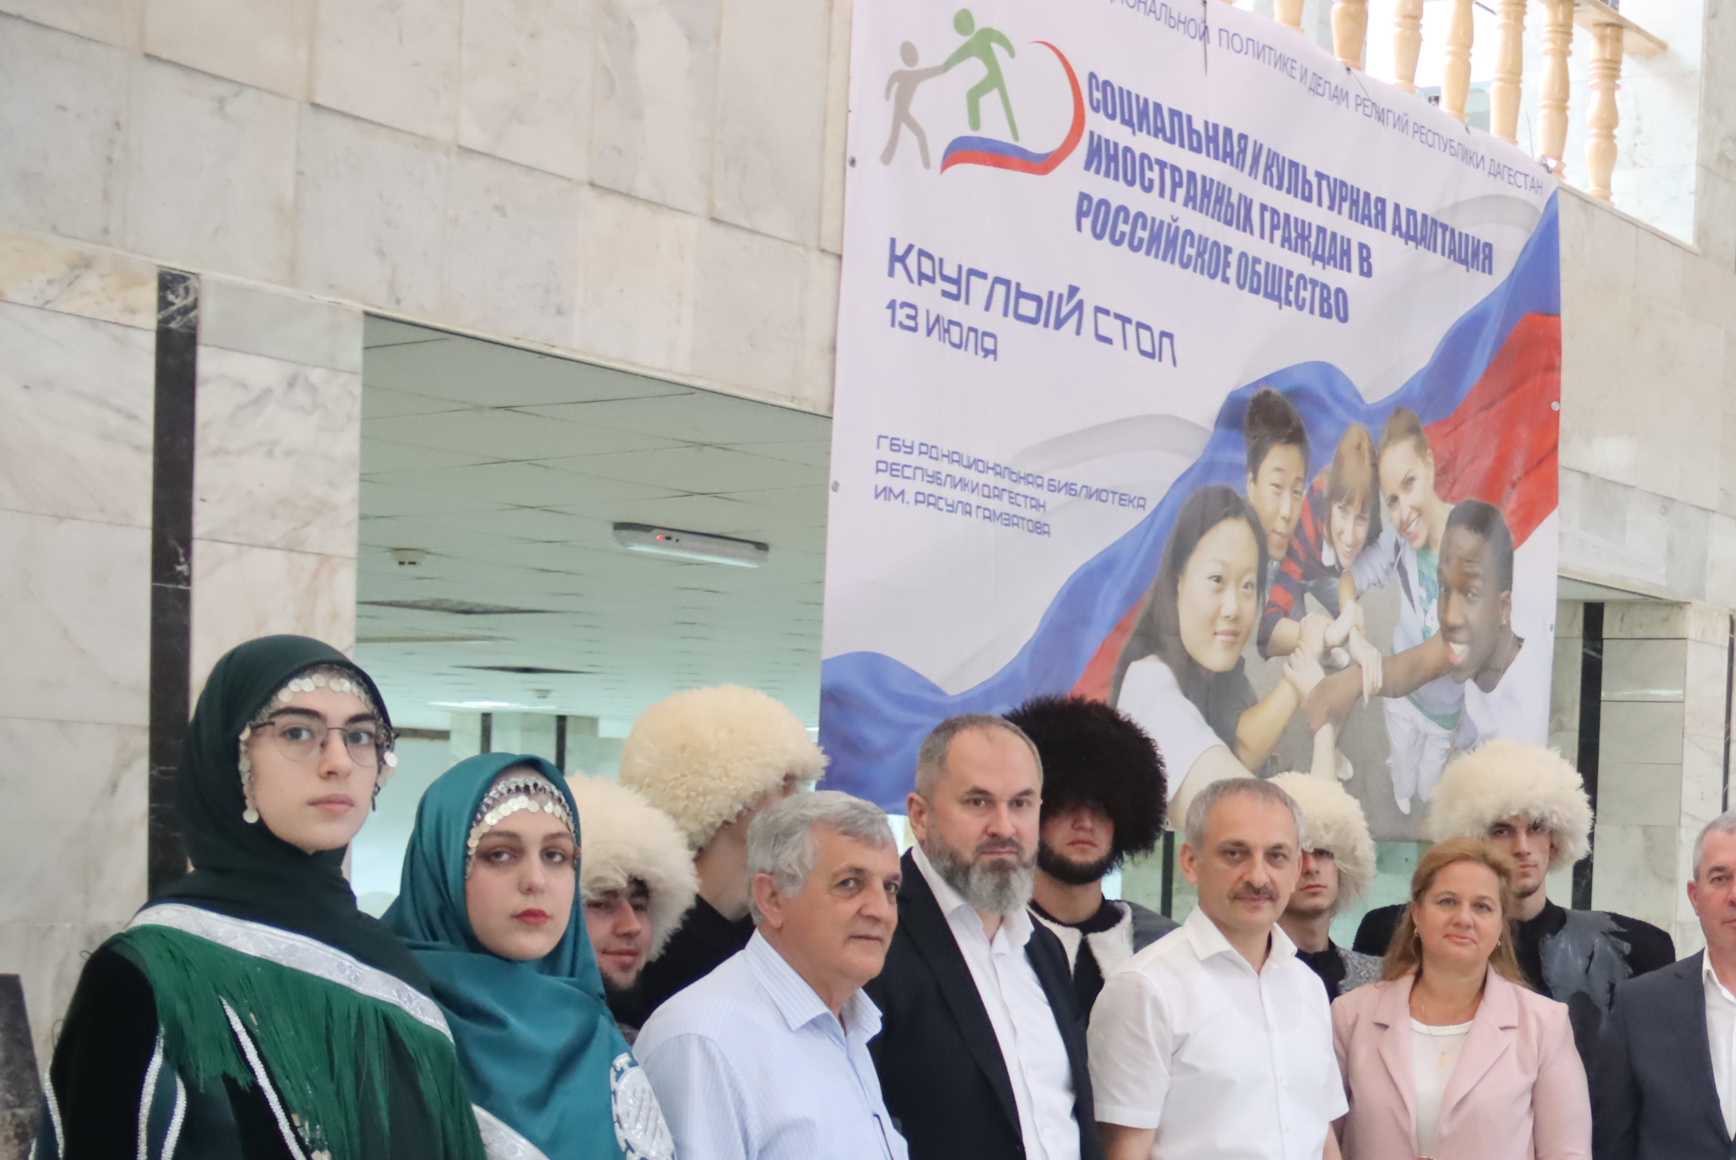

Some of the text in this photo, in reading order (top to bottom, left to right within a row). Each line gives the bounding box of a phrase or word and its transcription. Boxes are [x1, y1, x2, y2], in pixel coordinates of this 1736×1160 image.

[1088, 71, 1494, 276] СОЦИАЛЬНАЯ И КУЛЬТУРНАЯ АДАПТАЦИЯ
[1218, 28, 1298, 80] ПОЛИТИКЕ
[1300, 64, 1308, 85] И
[1308, 72, 1349, 109] ДЕЛАМ
[1355, 94, 1409, 136] РЕЛИГИЙ
[1413, 122, 1486, 171] РЕСПУБЛИКИ
[1488, 158, 1543, 197] ДАГЕСТАН
[1075, 190, 1349, 324] РОССИЙСКОЕ ОБЩЕСТВО
[1083, 129, 1373, 278] ИНОСТРАННЫХ ГРАЖДАН В
[885, 299, 998, 361] 13 ИЮЛЯ
[887, 237, 1177, 368] КРУГЛЫЙ СТОЛ
[874, 484, 909, 504] ИМ.
[976, 505, 1051, 538] ГАМЗАТОВА
[875, 460, 1046, 514] РЕСПУБЛИКИ ДАГЕСТАН
[876, 435, 1147, 511] ГБУ РД НАЦИОНАЛЬНАЯ БИБЛИОТЕКА
